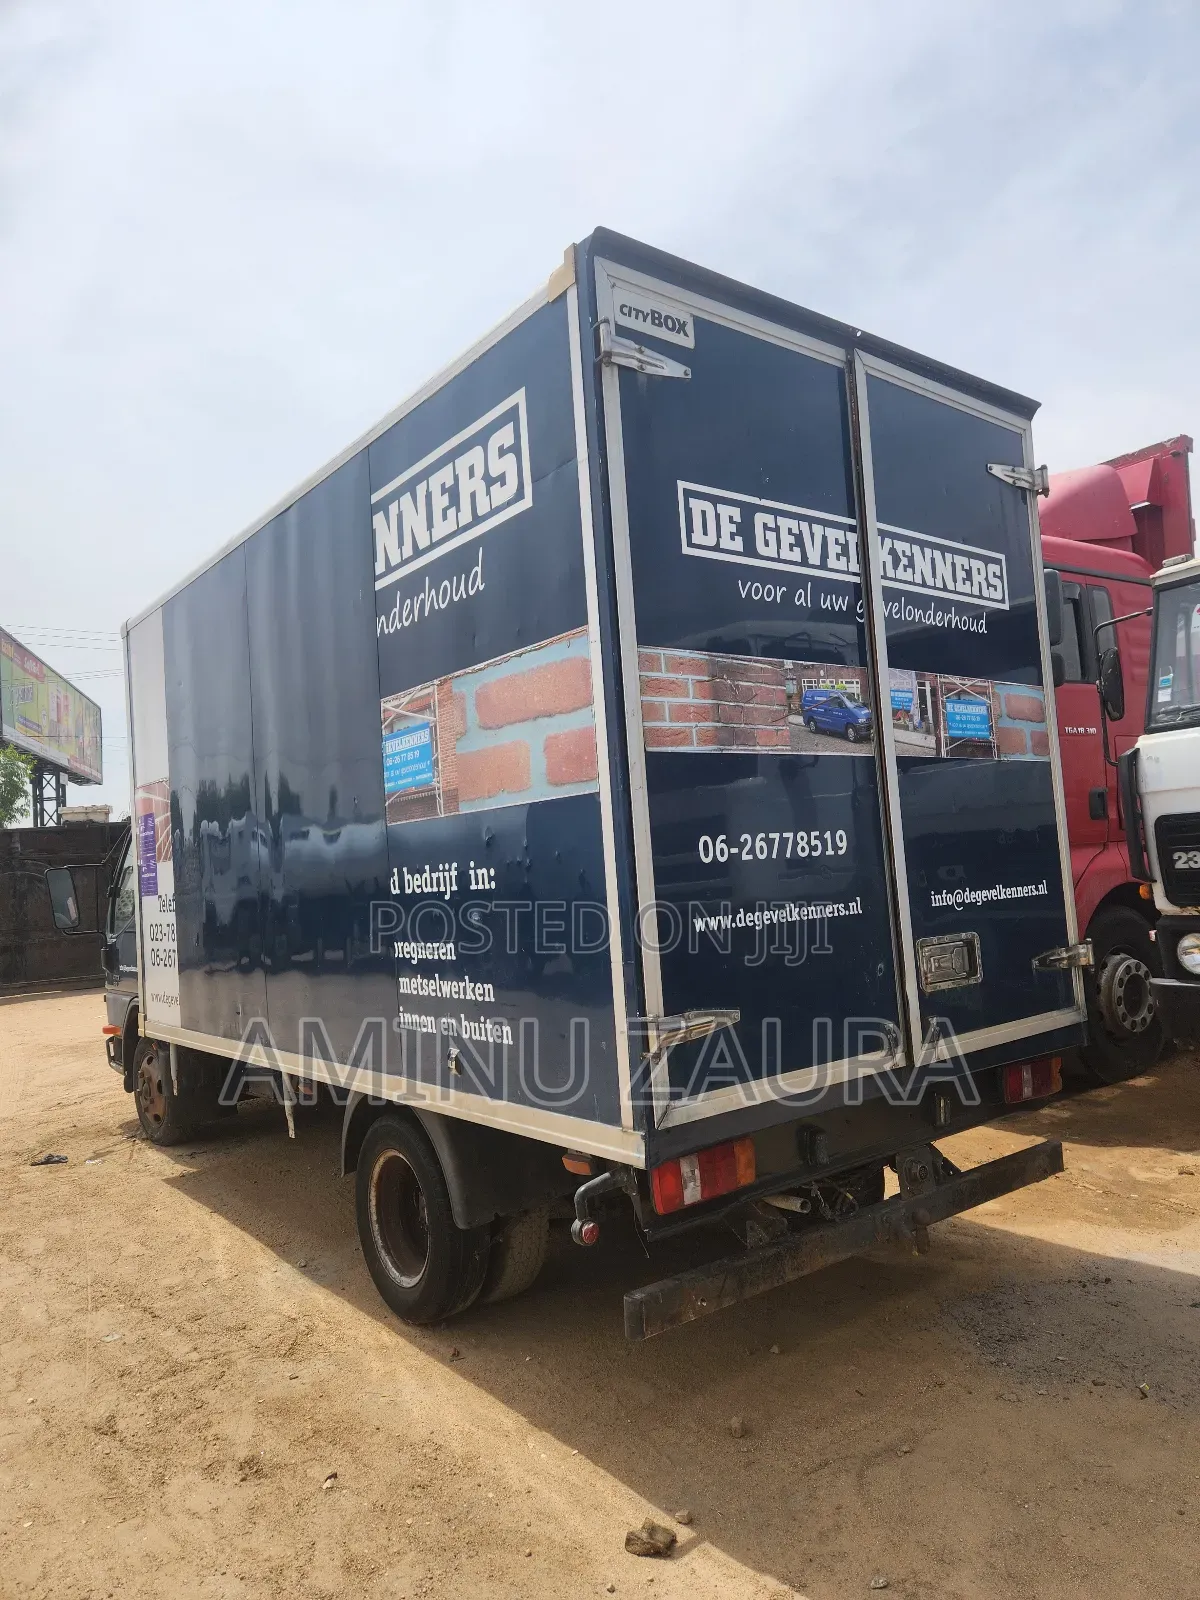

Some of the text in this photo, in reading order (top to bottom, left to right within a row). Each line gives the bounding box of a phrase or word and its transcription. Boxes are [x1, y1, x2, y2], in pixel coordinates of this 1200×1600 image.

[372, 421, 519, 576] NNERS
[688, 497, 744, 553] DE
[376, 546, 486, 637] nderhoud
[738, 579, 988, 634] voor al uw gvelonderhoud
[698, 829, 849, 864] 06-26778519
[403, 861, 458, 901] bedrijf
[468, 860, 496, 891] in:
[930, 879, 1048, 911] info@degevelkenners.nl
[692, 896, 863, 933] www.degevelkenners.nl
[398, 973, 495, 1002] metselwerken
[398, 1006, 513, 1046] innen en buiten
